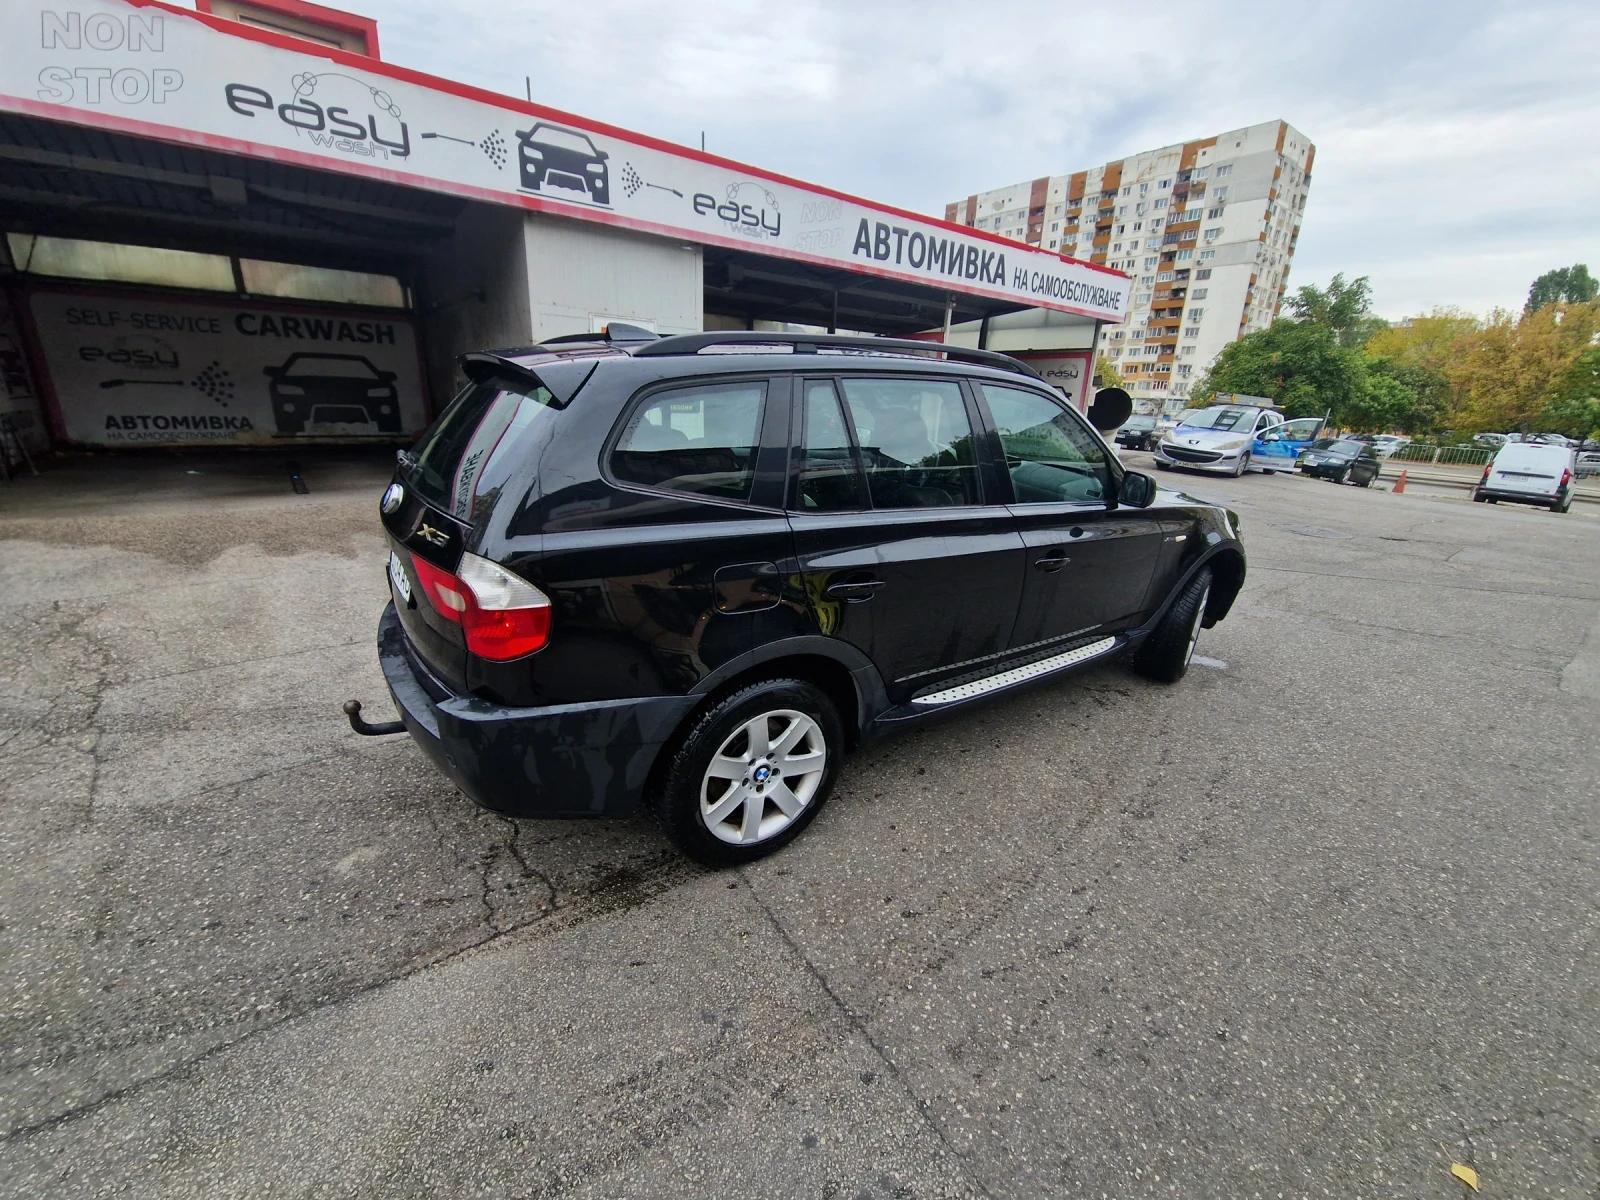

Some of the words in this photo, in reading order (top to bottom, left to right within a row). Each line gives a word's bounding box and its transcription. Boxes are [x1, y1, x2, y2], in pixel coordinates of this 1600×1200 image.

[41, 10, 164, 52] NON
[37, 66, 184, 104] STOP
[225, 83, 410, 156] easy
[307, 130, 389, 160] wash
[693, 193, 781, 236] easy
[800, 200, 843, 224] NON
[795, 227, 844, 251] STOP
[852, 217, 1006, 286] АВТОМИВКА
[1013, 266, 1028, 291] НА
[1031, 271, 1122, 310] САМООБСЛУЖВАНЕ
[66, 308, 221, 334] SELF-SERVICE
[235, 313, 396, 345] CARWASH
[79, 346, 180, 368] easy
[1047, 370, 1079, 379] easy
[105, 415, 254, 431] АВТОМИВКА
